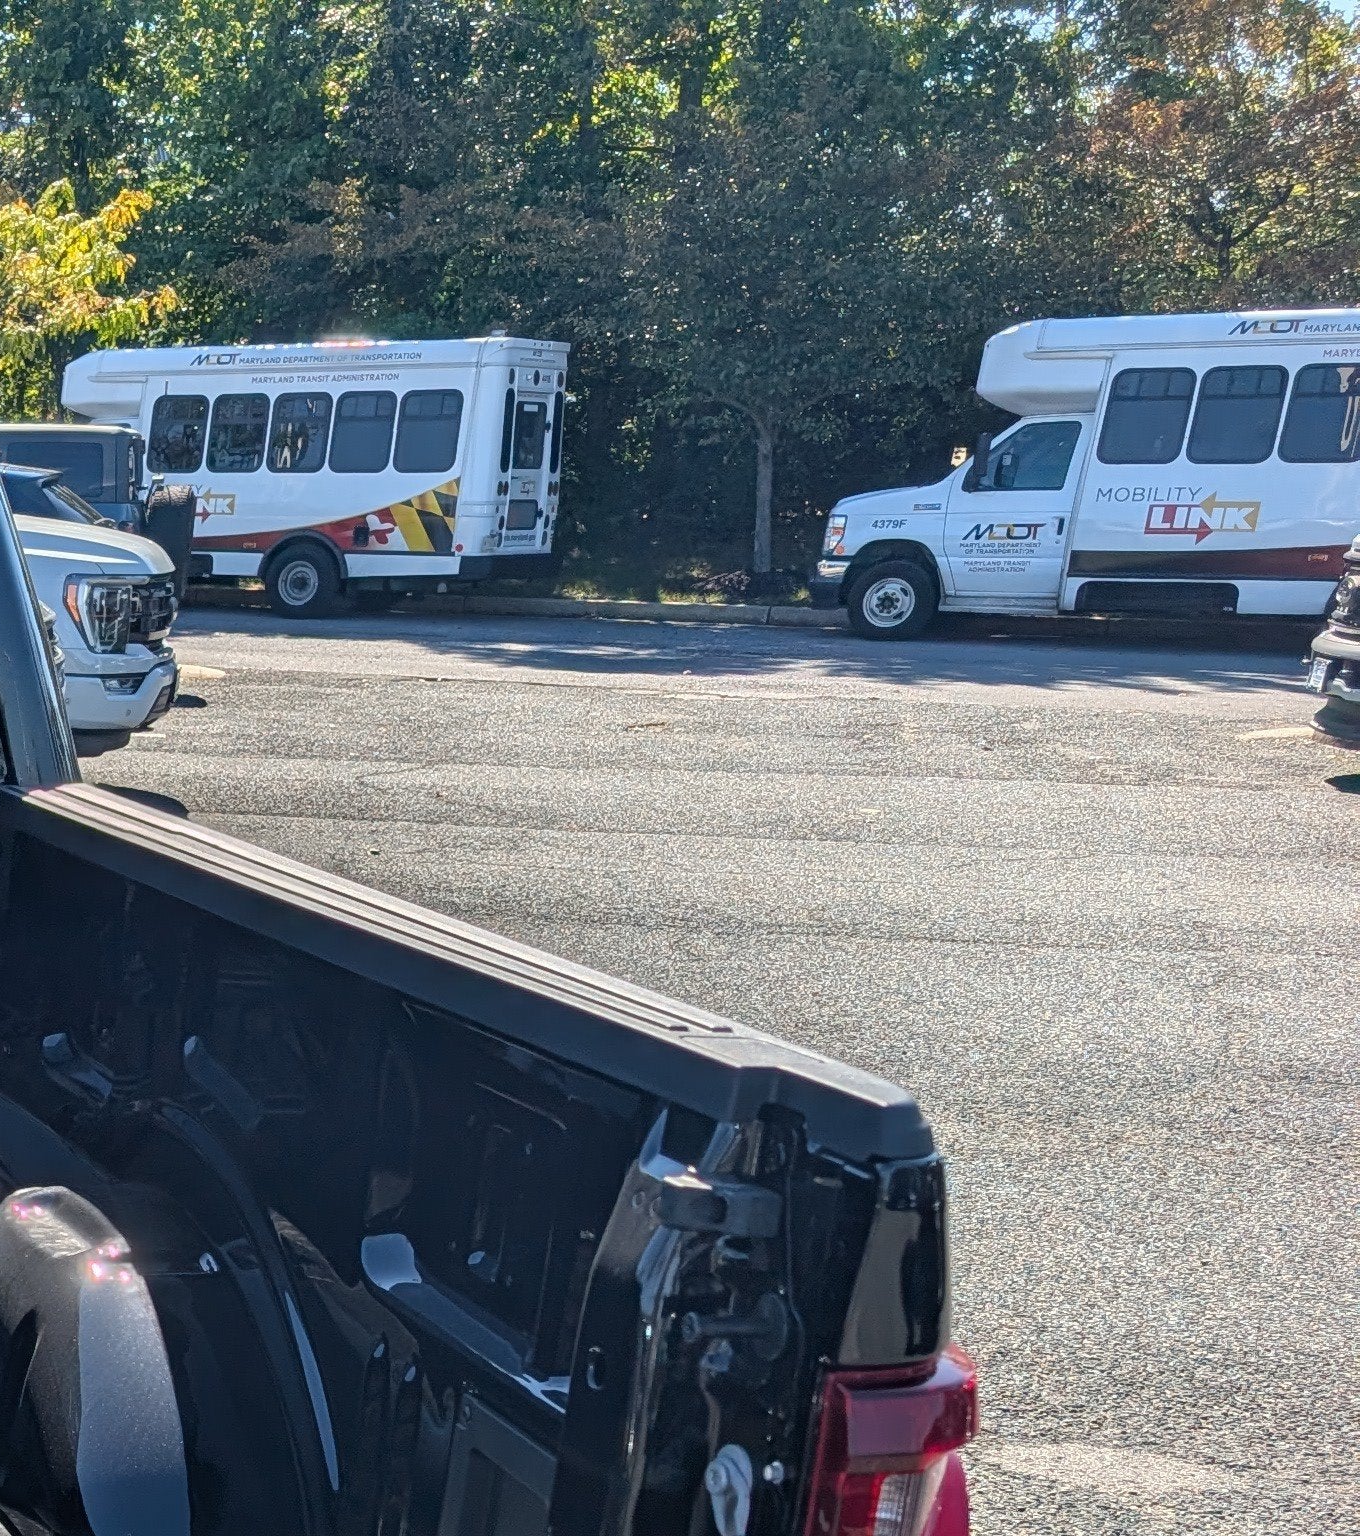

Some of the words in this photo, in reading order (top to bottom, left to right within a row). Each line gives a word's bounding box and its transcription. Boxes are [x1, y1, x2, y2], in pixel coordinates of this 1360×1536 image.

[240, 357, 281, 365] MARYLAND
[351, 352, 422, 362] TRANSPORTATION
[251, 376, 294, 384] MARYLAND
[296, 374, 330, 383] TRANSIT
[331, 372, 399, 382] ADMINISTRATION
[1095, 486, 1203, 502] MOBILITY
[872, 519, 908, 530] 4379F
[1148, 506, 1255, 530] LINK
